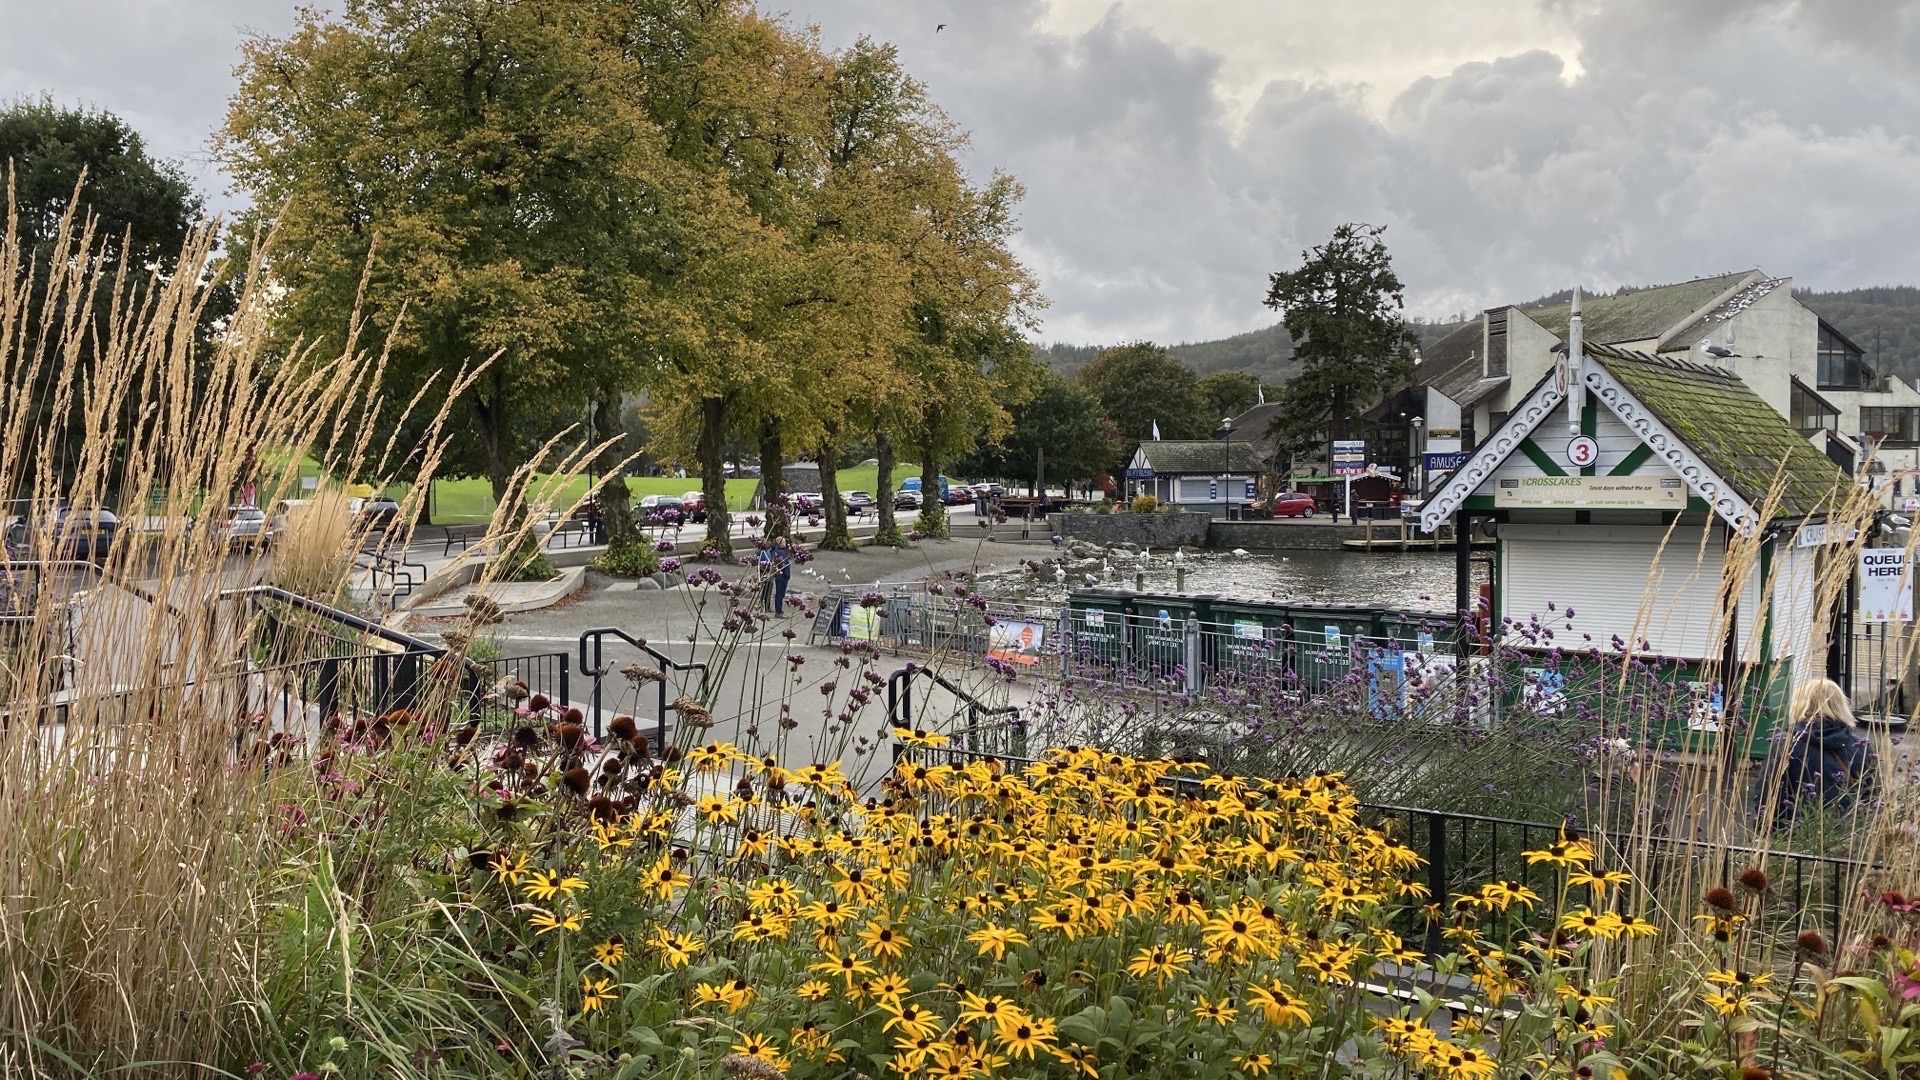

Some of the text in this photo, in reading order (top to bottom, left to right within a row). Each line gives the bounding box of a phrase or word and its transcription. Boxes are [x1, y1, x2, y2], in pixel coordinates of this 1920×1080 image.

[1559, 363, 1566, 392] 3
[1575, 443, 1590, 462] 3
[1526, 477, 1582, 487] CROSSLAKES
[1521, 486, 1582, 498] Experience
[1868, 567, 1904, 577] HERE
